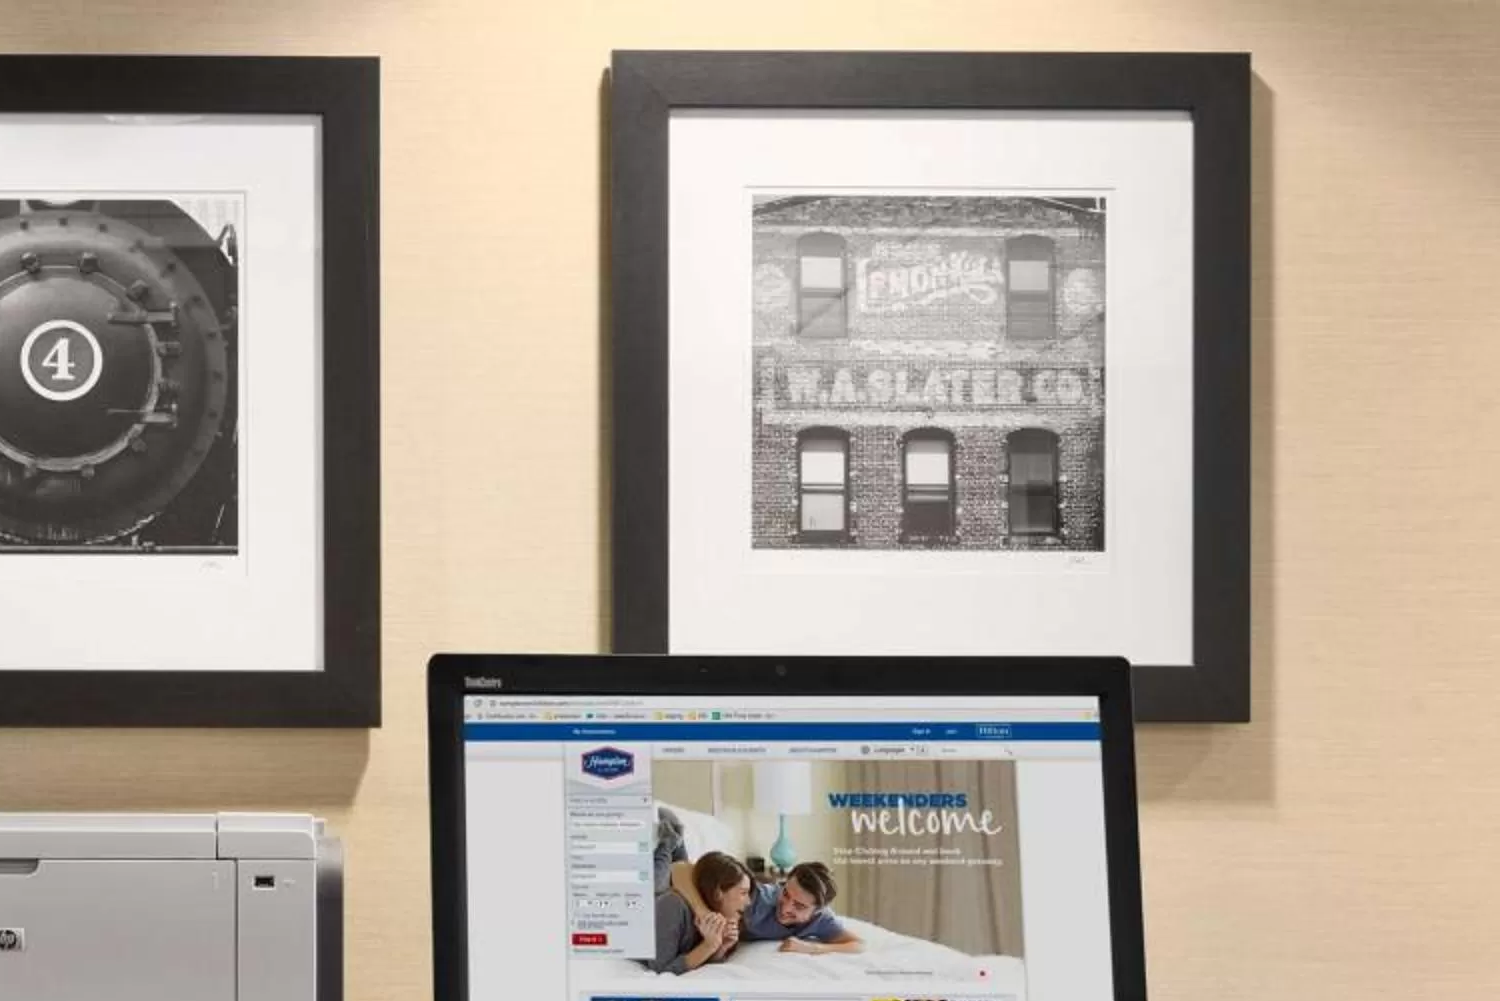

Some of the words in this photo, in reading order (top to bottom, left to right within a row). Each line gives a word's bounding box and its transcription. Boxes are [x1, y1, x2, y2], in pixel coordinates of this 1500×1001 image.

[41, 336, 76, 382] 4
[867, 367, 1024, 404] SLATER
[828, 793, 968, 808] WEEKENDERS
[851, 797, 1003, 837] welcome
